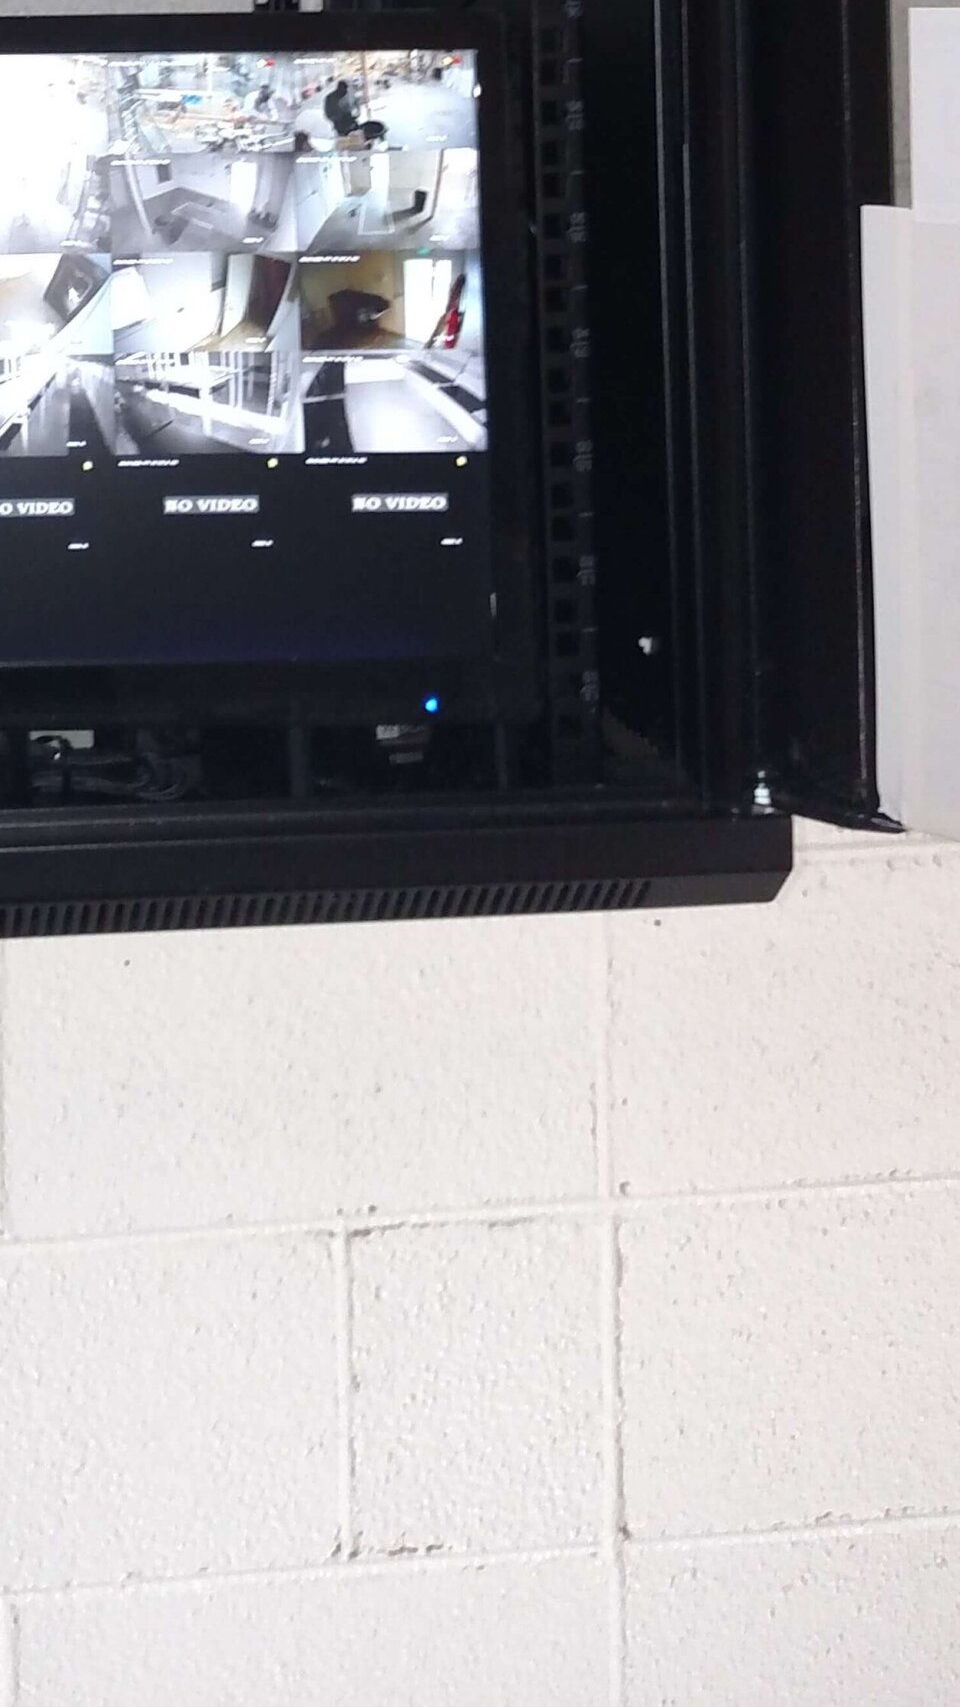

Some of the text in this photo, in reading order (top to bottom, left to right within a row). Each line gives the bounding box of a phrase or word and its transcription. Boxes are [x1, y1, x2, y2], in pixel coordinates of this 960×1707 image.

[17, 501, 74, 515] VIDEO
[165, 498, 258, 513] NO VIDEO
[353, 495, 447, 511] NO VIDEO
